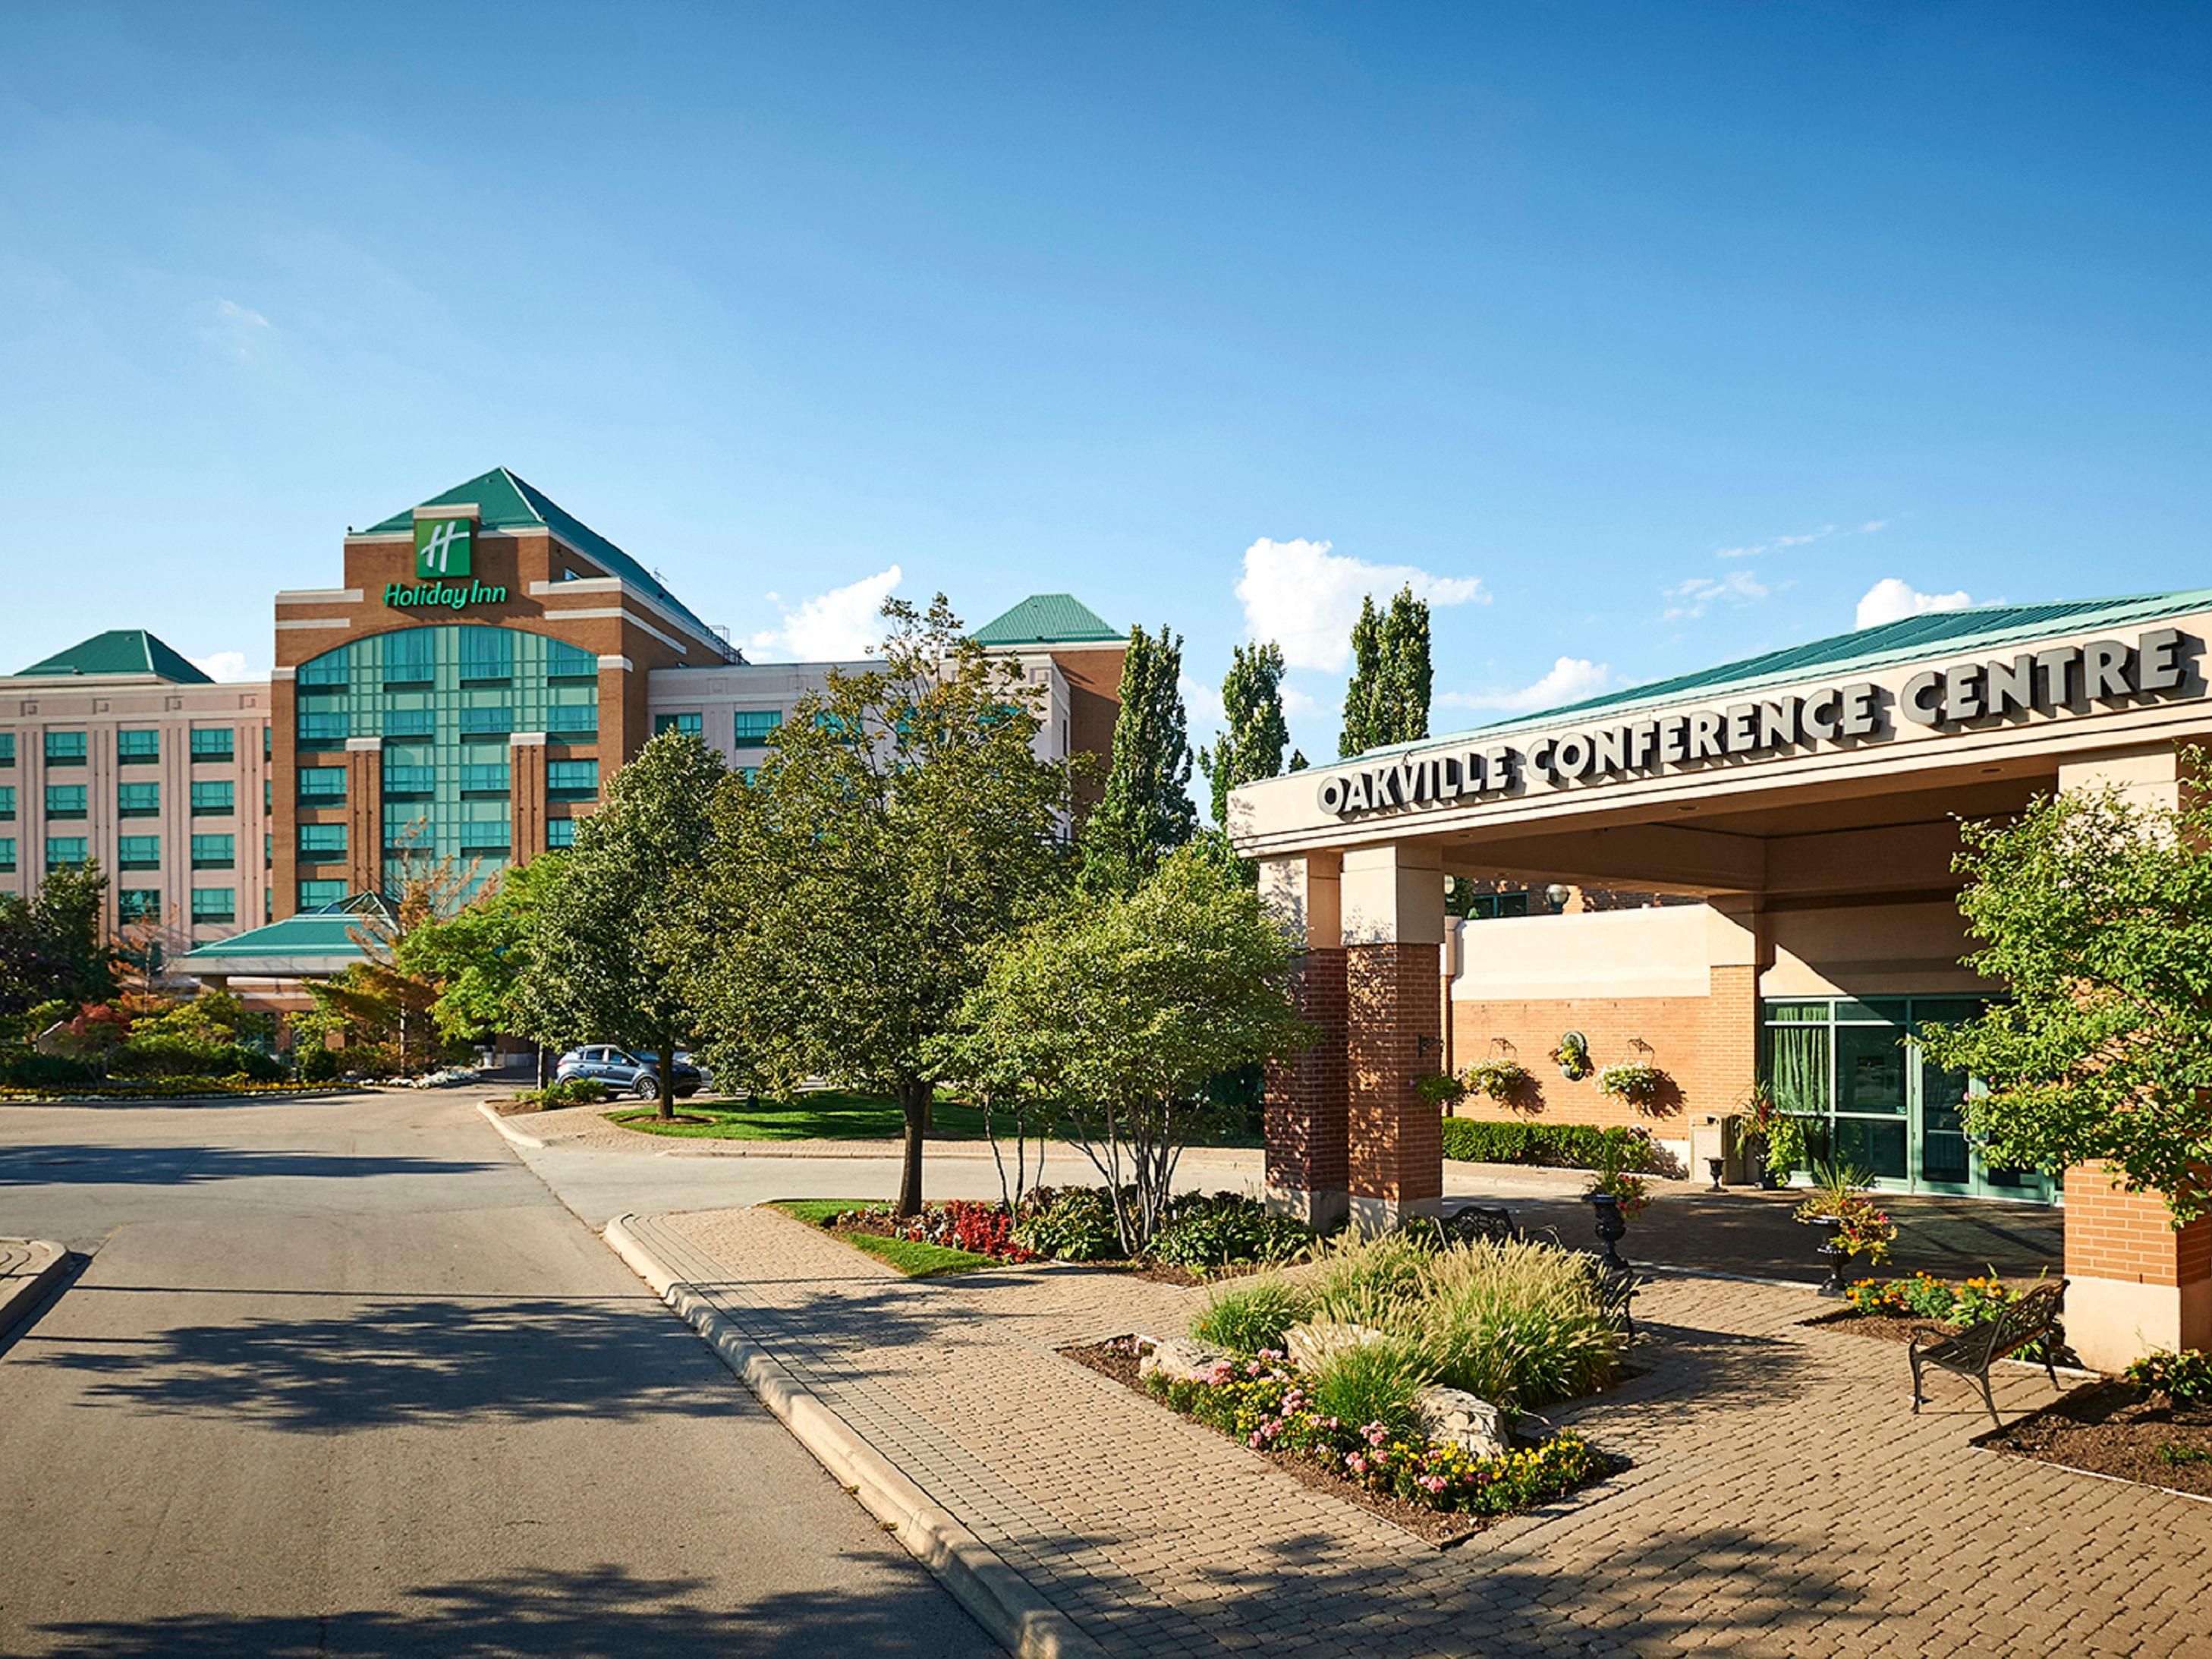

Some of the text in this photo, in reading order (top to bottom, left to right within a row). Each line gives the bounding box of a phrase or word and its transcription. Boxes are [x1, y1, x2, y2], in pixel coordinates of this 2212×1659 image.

[420, 521, 470, 574] H
[383, 579, 508, 609] Holiday Inn
[1317, 628, 2185, 816] OAKVILLE CONFERENCE CENTRE
